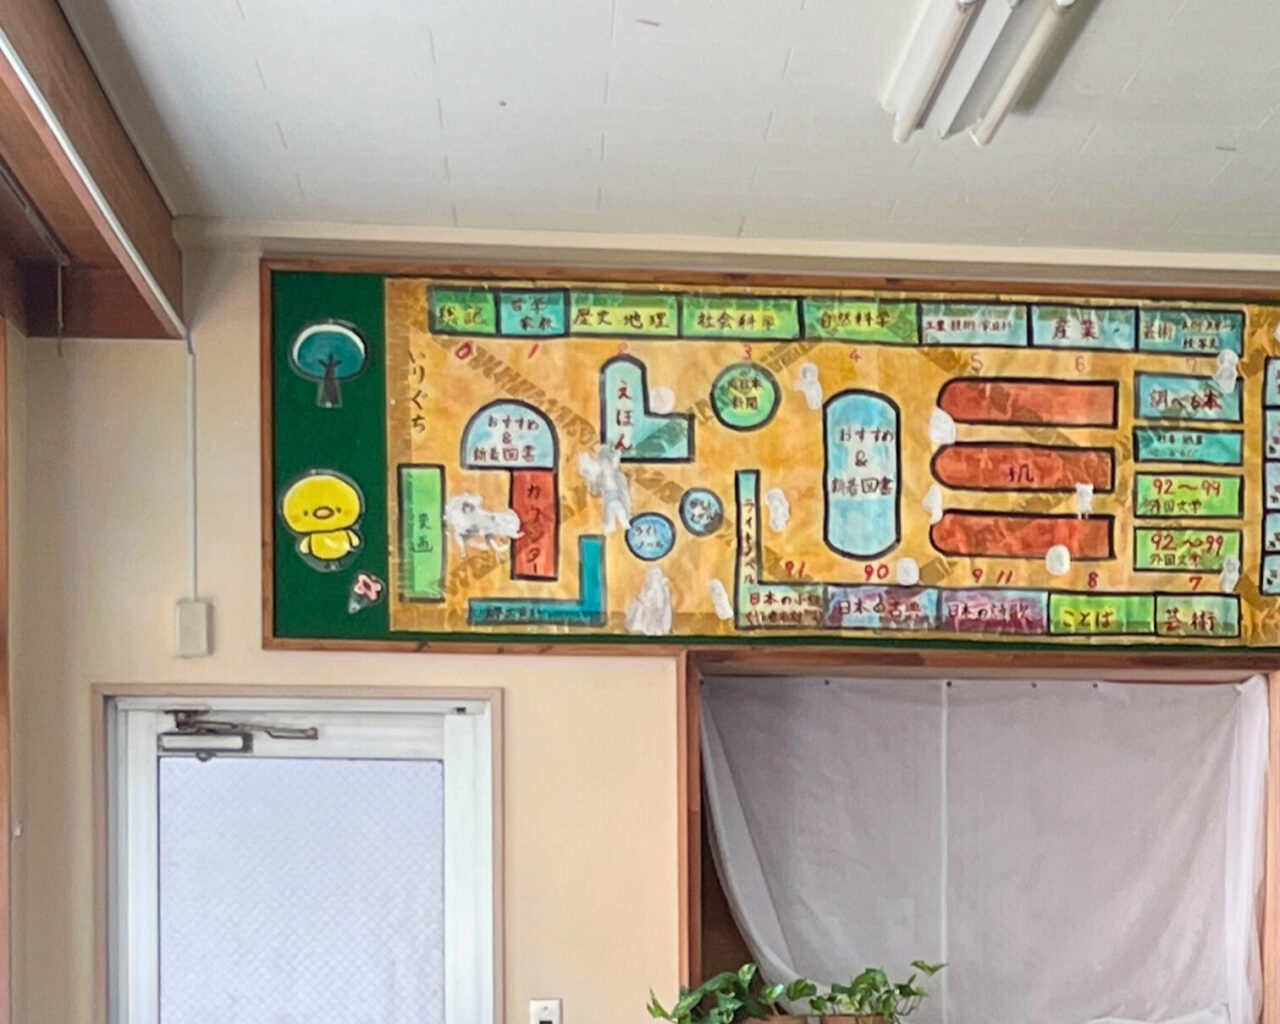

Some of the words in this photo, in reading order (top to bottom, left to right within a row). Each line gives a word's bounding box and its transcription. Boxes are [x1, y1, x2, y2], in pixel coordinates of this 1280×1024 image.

[623, 311, 669, 329] 地理
[697, 311, 777, 331] 社会科学
[1052, 318, 1100, 341] 産業
[742, 344, 752, 361] 3
[850, 348, 862, 363] 4
[970, 355, 984, 373] 5
[1074, 356, 1087, 373] 6
[408, 350, 430, 434] いりぐち
[488, 415, 540, 431] おすすめ
[613, 378, 633, 452] えほん
[502, 431, 512, 444] &
[839, 428, 894, 442] おすすめ
[855, 450, 868, 468] &
[1008, 462, 1034, 482] 机
[864, 563, 890, 581] 90
[1088, 571, 1099, 589] 8
[1189, 576, 1203, 591] 7
[1062, 610, 1115, 629] ことば
[1165, 608, 1216, 632] 芸術
